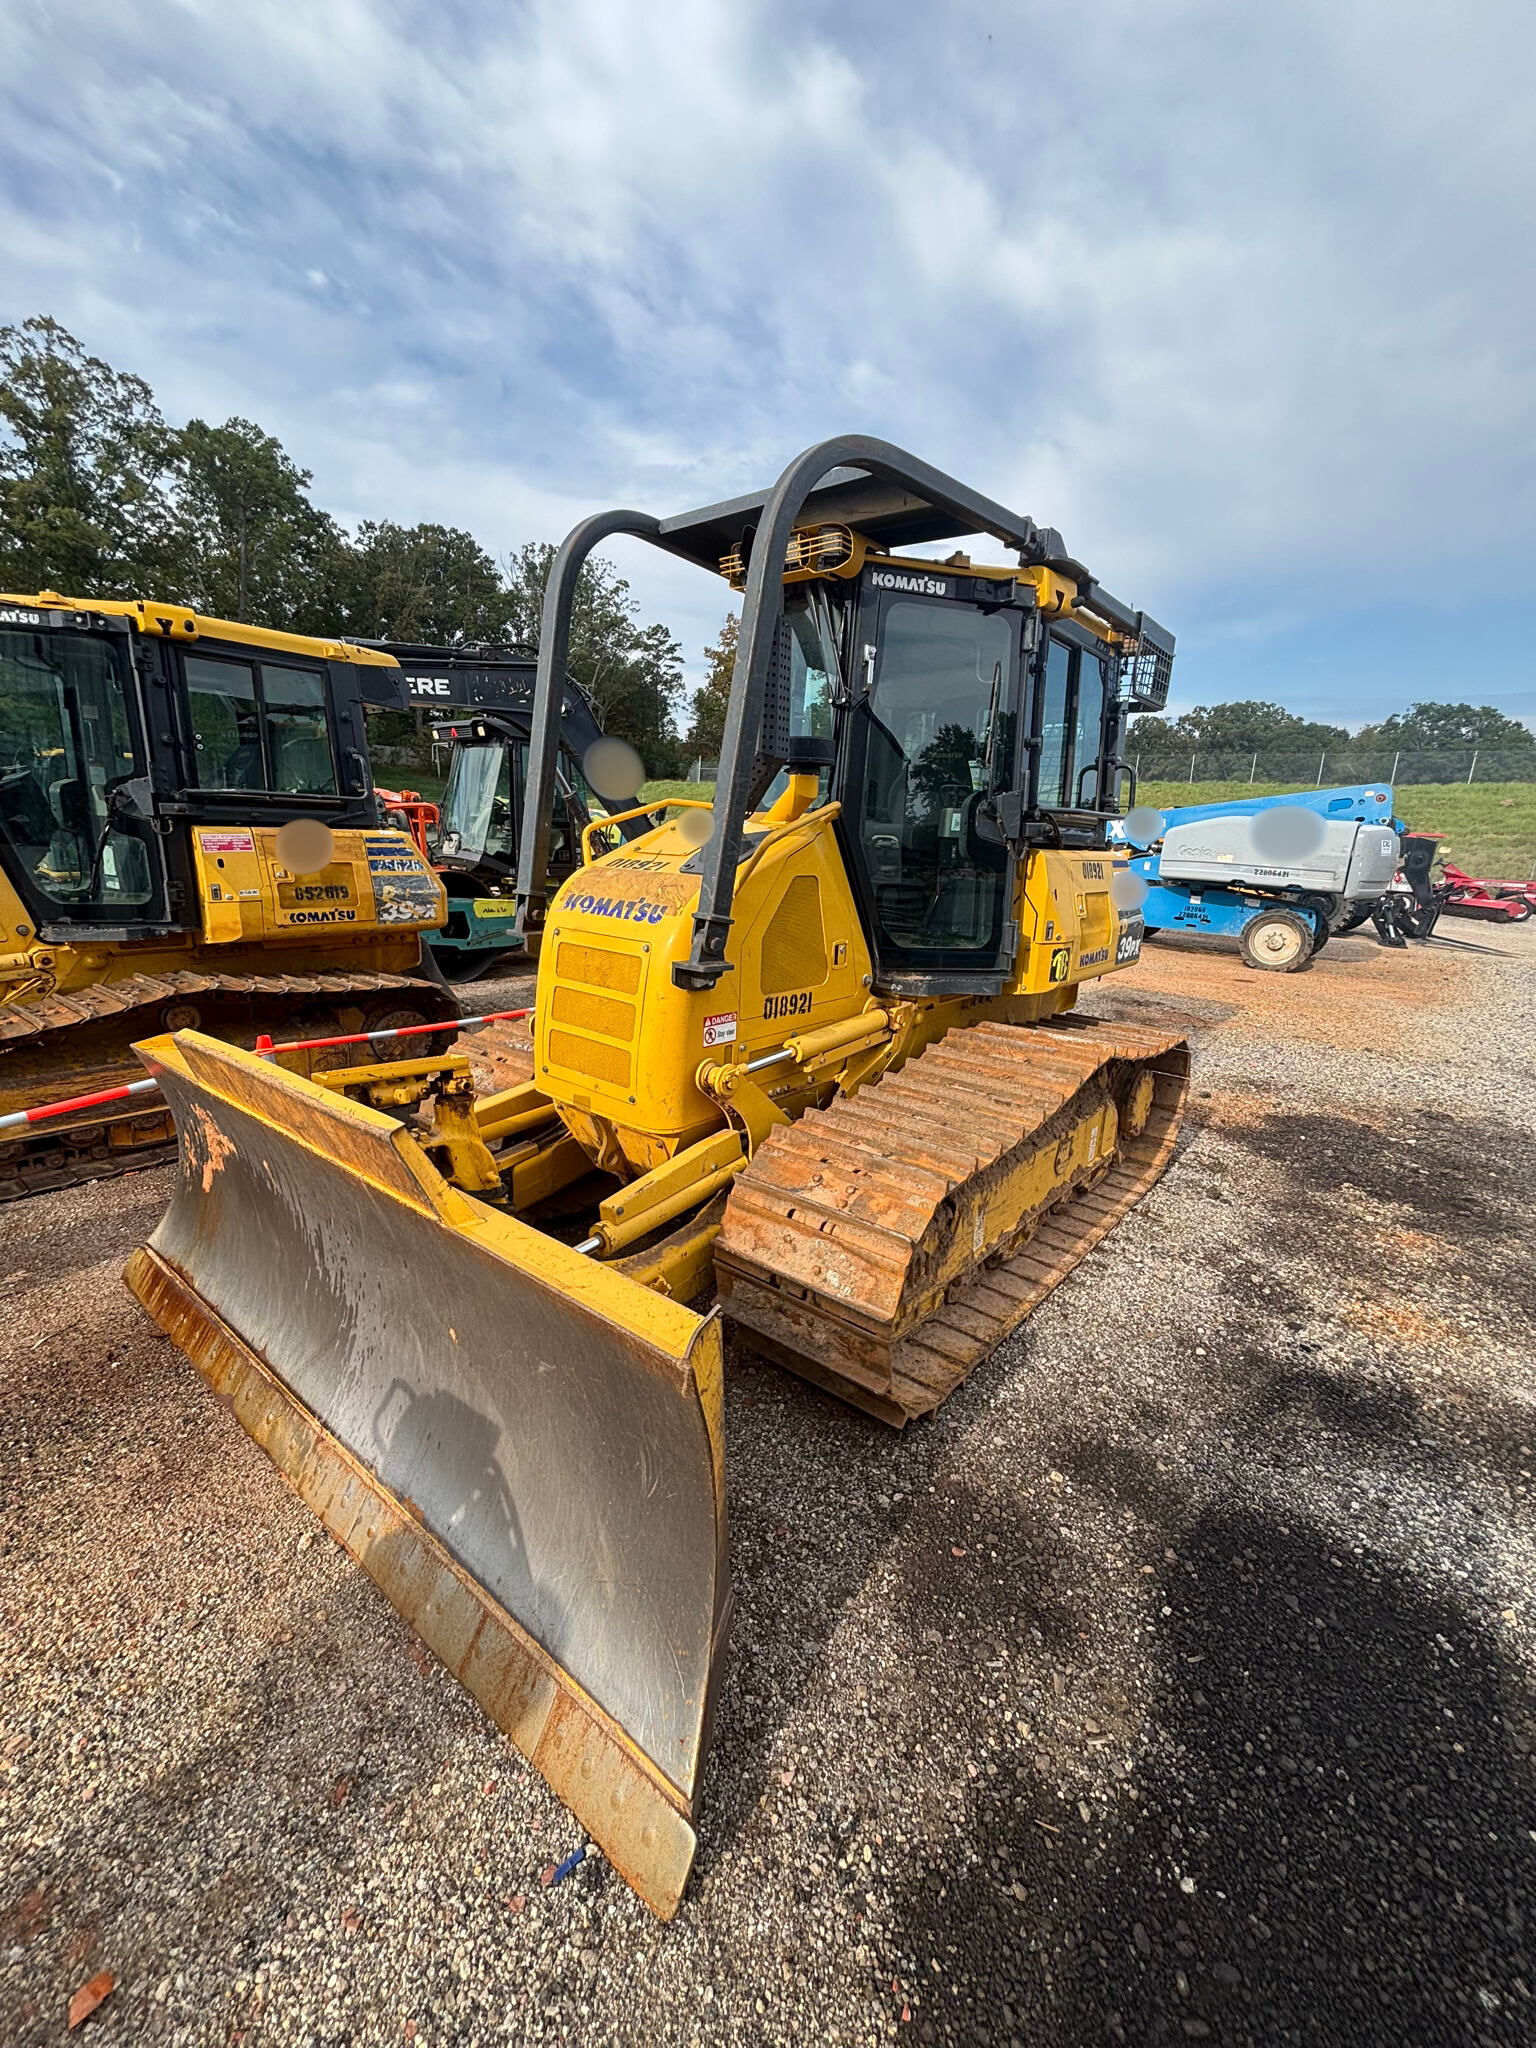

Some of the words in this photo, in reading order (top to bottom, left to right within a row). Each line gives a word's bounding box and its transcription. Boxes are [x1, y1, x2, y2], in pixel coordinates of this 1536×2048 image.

[872, 572, 947, 596] KOMATSU
[605, 857, 671, 872] 018921
[1082, 861, 1104, 880] 018921
[1254, 868, 1290, 878] 22006421
[563, 893, 669, 924] KOMATSU
[1080, 947, 1109, 968] KOMATSU
[763, 991, 813, 1020] 018921
[711, 1012, 738, 1025] DANGER
